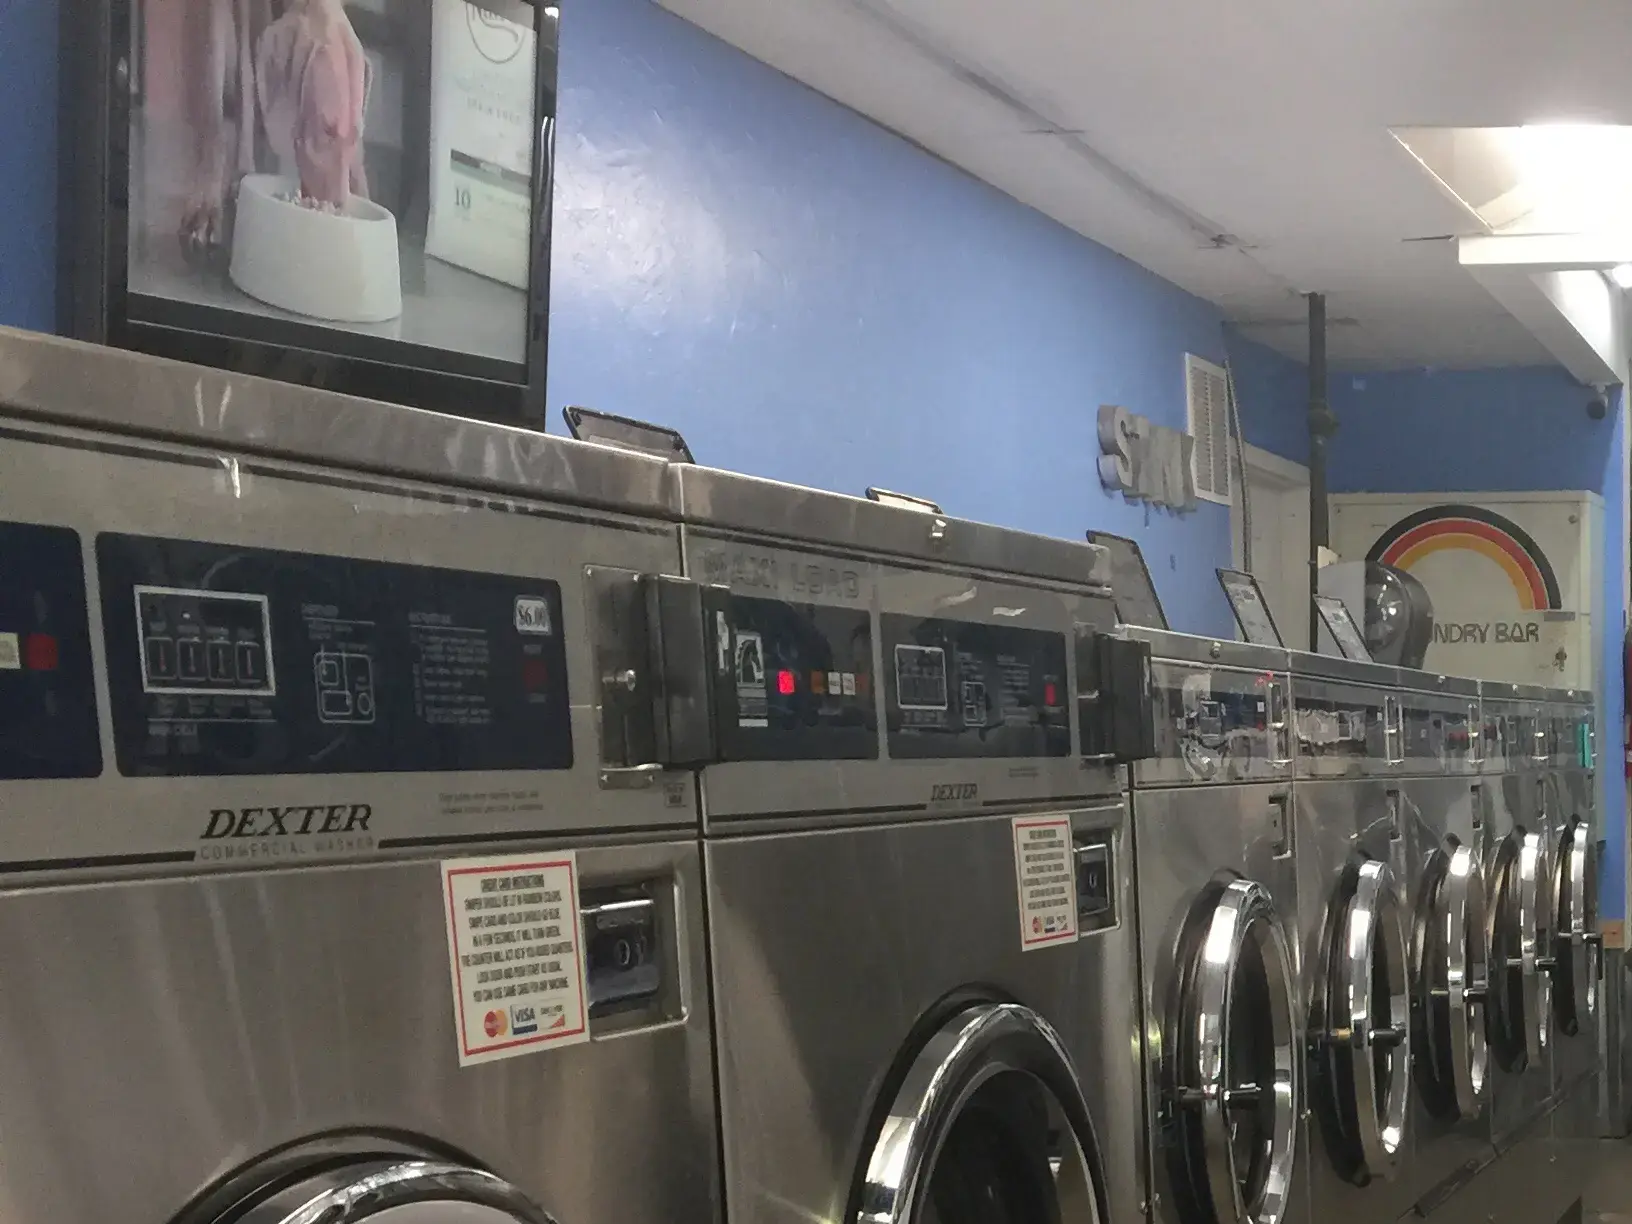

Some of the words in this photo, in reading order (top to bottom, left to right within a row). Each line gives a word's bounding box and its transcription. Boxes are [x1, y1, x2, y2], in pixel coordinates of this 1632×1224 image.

[1433, 622, 1490, 644] NDRY
[1494, 622, 1540, 643] BAR
[931, 783, 978, 801] DEXTER
[199, 803, 373, 840] DEXTER
[514, 1007, 536, 1023] VISA
